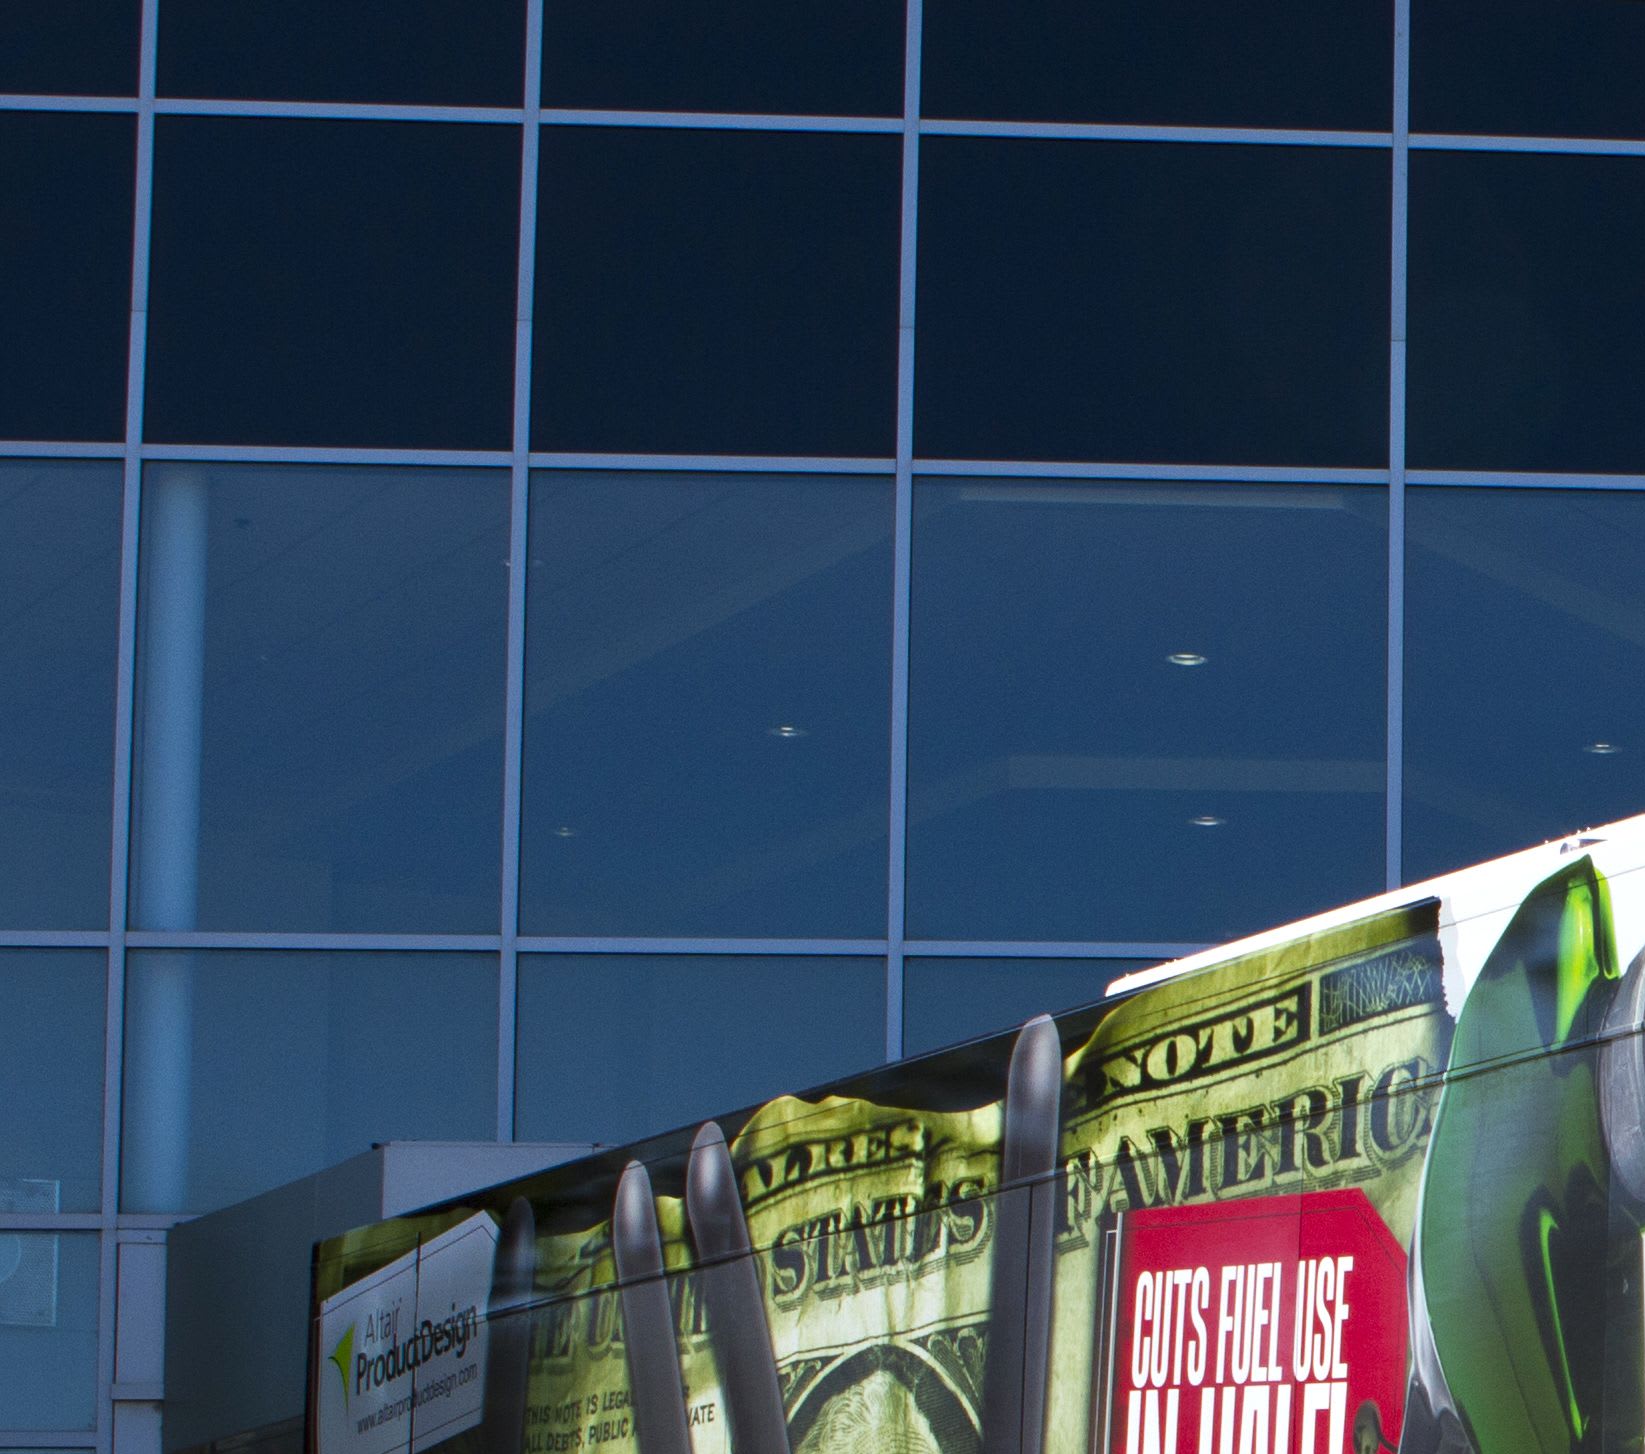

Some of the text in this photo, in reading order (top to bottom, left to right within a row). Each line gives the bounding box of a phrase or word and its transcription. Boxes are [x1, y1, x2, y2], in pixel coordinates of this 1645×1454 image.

[1102, 995, 1300, 1097] NOTE
[1100, 1055, 1436, 1216] AMERIC
[356, 1302, 479, 1397] ProductDesign
[365, 1299, 401, 1347] Altair
[1130, 1256, 1354, 1389] CUTS FUEL USE
